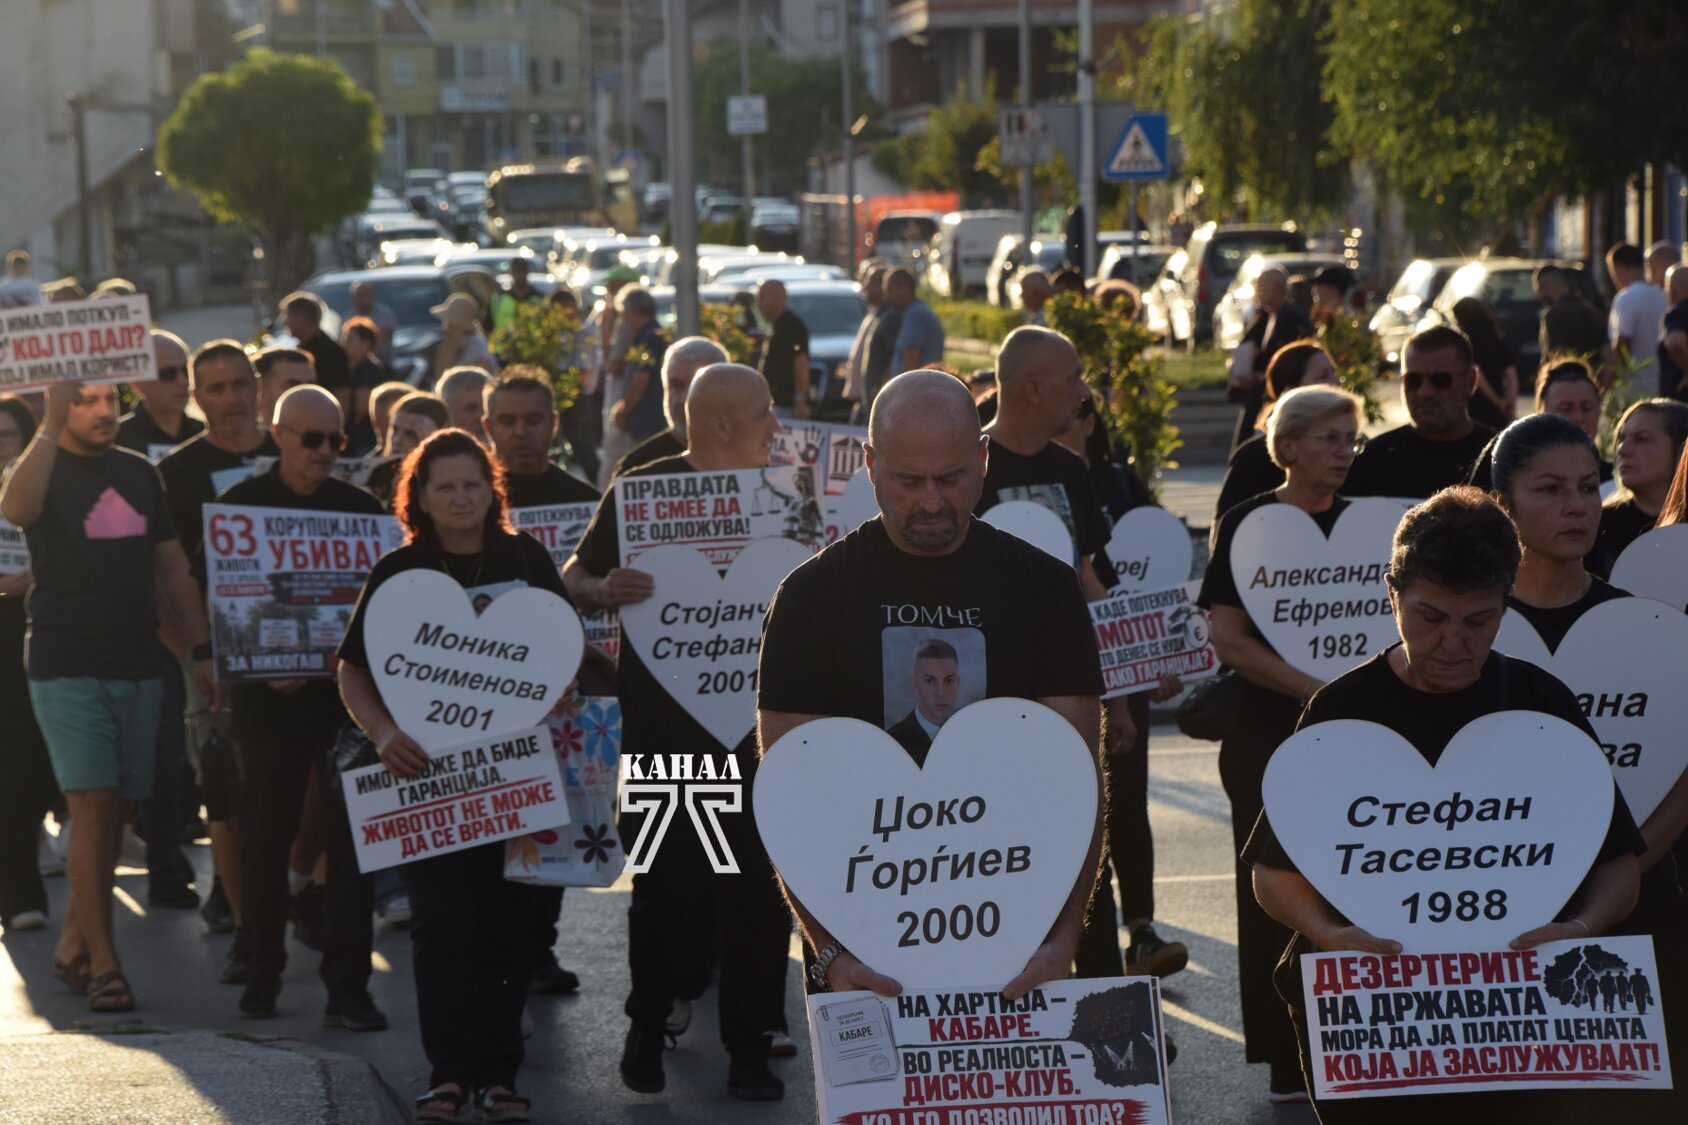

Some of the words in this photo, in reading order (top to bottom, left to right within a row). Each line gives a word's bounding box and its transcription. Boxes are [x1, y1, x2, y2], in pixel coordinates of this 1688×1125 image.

[8, 311, 63, 333] ИМАЛО
[67, 304, 129, 326] ПОТКУП
[12, 333, 54, 361] КОЈ
[58, 331, 83, 356] ГО
[88, 324, 146, 356] ДАЛ?
[28, 359, 77, 381] ИМАЛ
[80, 353, 149, 376] КОРИСТ?
[622, 473, 740, 501] ПРАВДАТА
[624, 501, 652, 522] НЕ
[655, 498, 708, 520] СМЕЕ
[712, 496, 741, 519] ДА
[210, 513, 257, 557] 63
[264, 515, 381, 538] КОРУПЦИЈАТА
[625, 521, 647, 542] СЕ
[649, 516, 751, 542] ОДЛОЖУВА!
[268, 539, 382, 571] УБИВА!
[880, 603, 983, 628] ТОМЧЕ
[1094, 599, 1128, 621] КАДЕ
[1128, 586, 1190, 614] ПОТЕКНУВА
[413, 622, 529, 662] Моника
[1115, 645, 1149, 665] ДЕНЕС
[1148, 640, 1161, 657] СЕ
[1308, 633, 1367, 660] 1982
[226, 655, 248, 672] ЗА
[383, 653, 548, 702] Стоименова
[1137, 652, 1210, 683] ГАРАНЦИЈА?
[697, 668, 759, 695] 2001
[425, 700, 494, 731] 2001
[462, 748, 488, 770] ДА
[490, 735, 540, 763] БИДЕ
[398, 766, 507, 807] ГАРАНЦИЈА.
[361, 804, 457, 846] ЖИВОТОТ
[461, 797, 488, 821] НЕ
[491, 781, 556, 815] МОЖЕ
[872, 794, 987, 843] Џоко
[1346, 791, 1533, 832] Стефан
[400, 834, 429, 859] ДА
[432, 829, 457, 849] СЕ
[458, 812, 527, 843] ВРАТИ.
[845, 844, 1031, 897] Ѓорѓиев
[1334, 842, 1555, 876] Тасевски
[1400, 889, 1508, 925] 1988
[896, 900, 1001, 949] 2000
[1313, 950, 1542, 996] ДЕЗЕРТЕРИТЕ
[896, 994, 930, 1019] НА
[937, 988, 1049, 1017] ХАРТИЈА
[1317, 994, 1364, 1027] НА
[1368, 985, 1548, 1027] ДРЖАВАТА
[838, 1025, 874, 1043] КАБАРЕ
[928, 1013, 1040, 1042] КАБАРЕ.
[1320, 1027, 1385, 1053] МОРА
[1387, 1024, 1422, 1051] ДА
[1425, 1022, 1456, 1046] ЈА
[1462, 1019, 1550, 1045] ПЛАТАТ
[1553, 1016, 1648, 1044] ЦЕНАТА
[903, 1050, 932, 1075] ВО
[938, 1044, 1068, 1073] РЕАЛНОСТА
[1322, 1051, 1399, 1083] КОЈА
[1402, 1049, 1439, 1079] ЈА
[1443, 1042, 1662, 1077] ЗАСЛУЖУВААТ!
[903, 1068, 1082, 1107] ДИСКО-КЛУБ.
[1071, 1102, 1126, 1125] ТОА?
